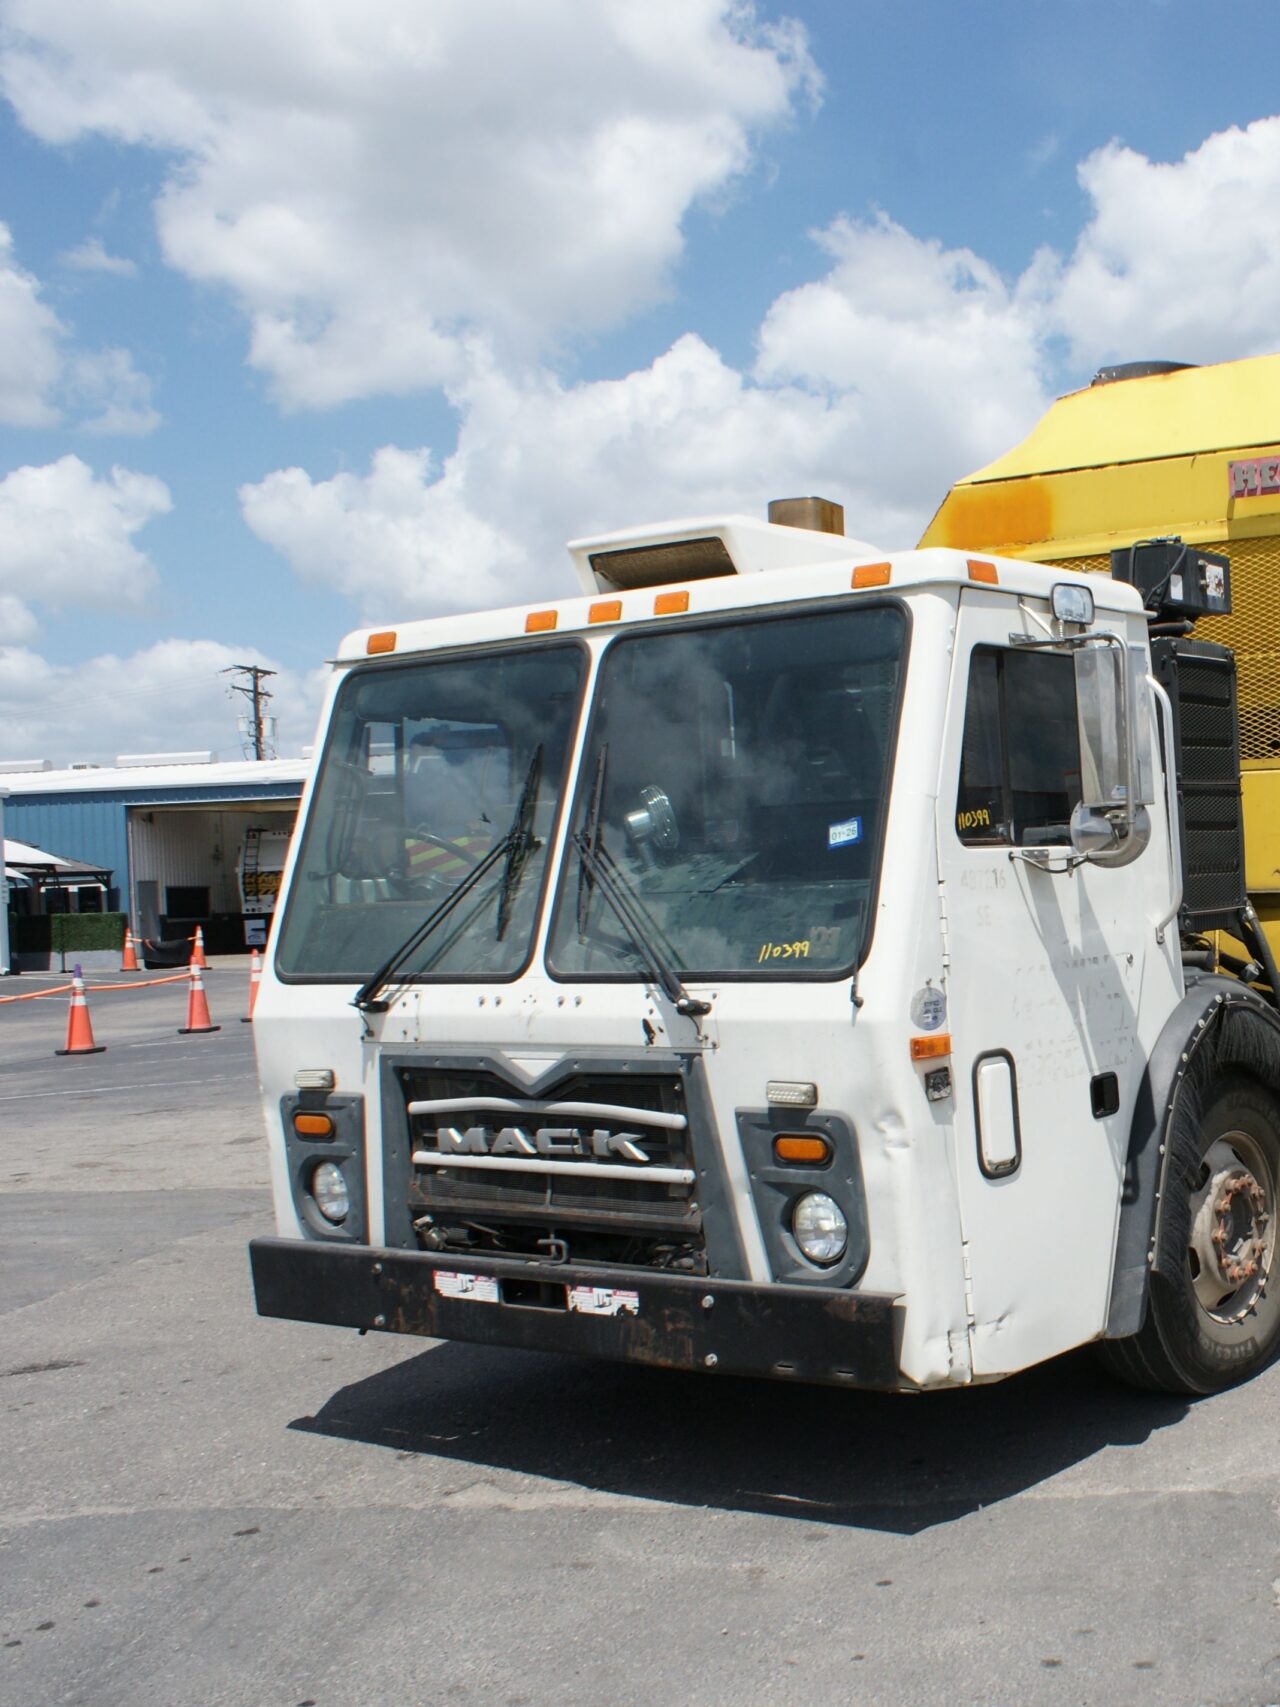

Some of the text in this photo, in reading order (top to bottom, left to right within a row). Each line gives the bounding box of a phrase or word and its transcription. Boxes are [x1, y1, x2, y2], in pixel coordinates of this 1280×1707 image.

[957, 808, 990, 831] 110399
[758, 940, 810, 963] 110399
[437, 1127, 650, 1162] MACK
[1200, 1338, 1256, 1360] Firesto
